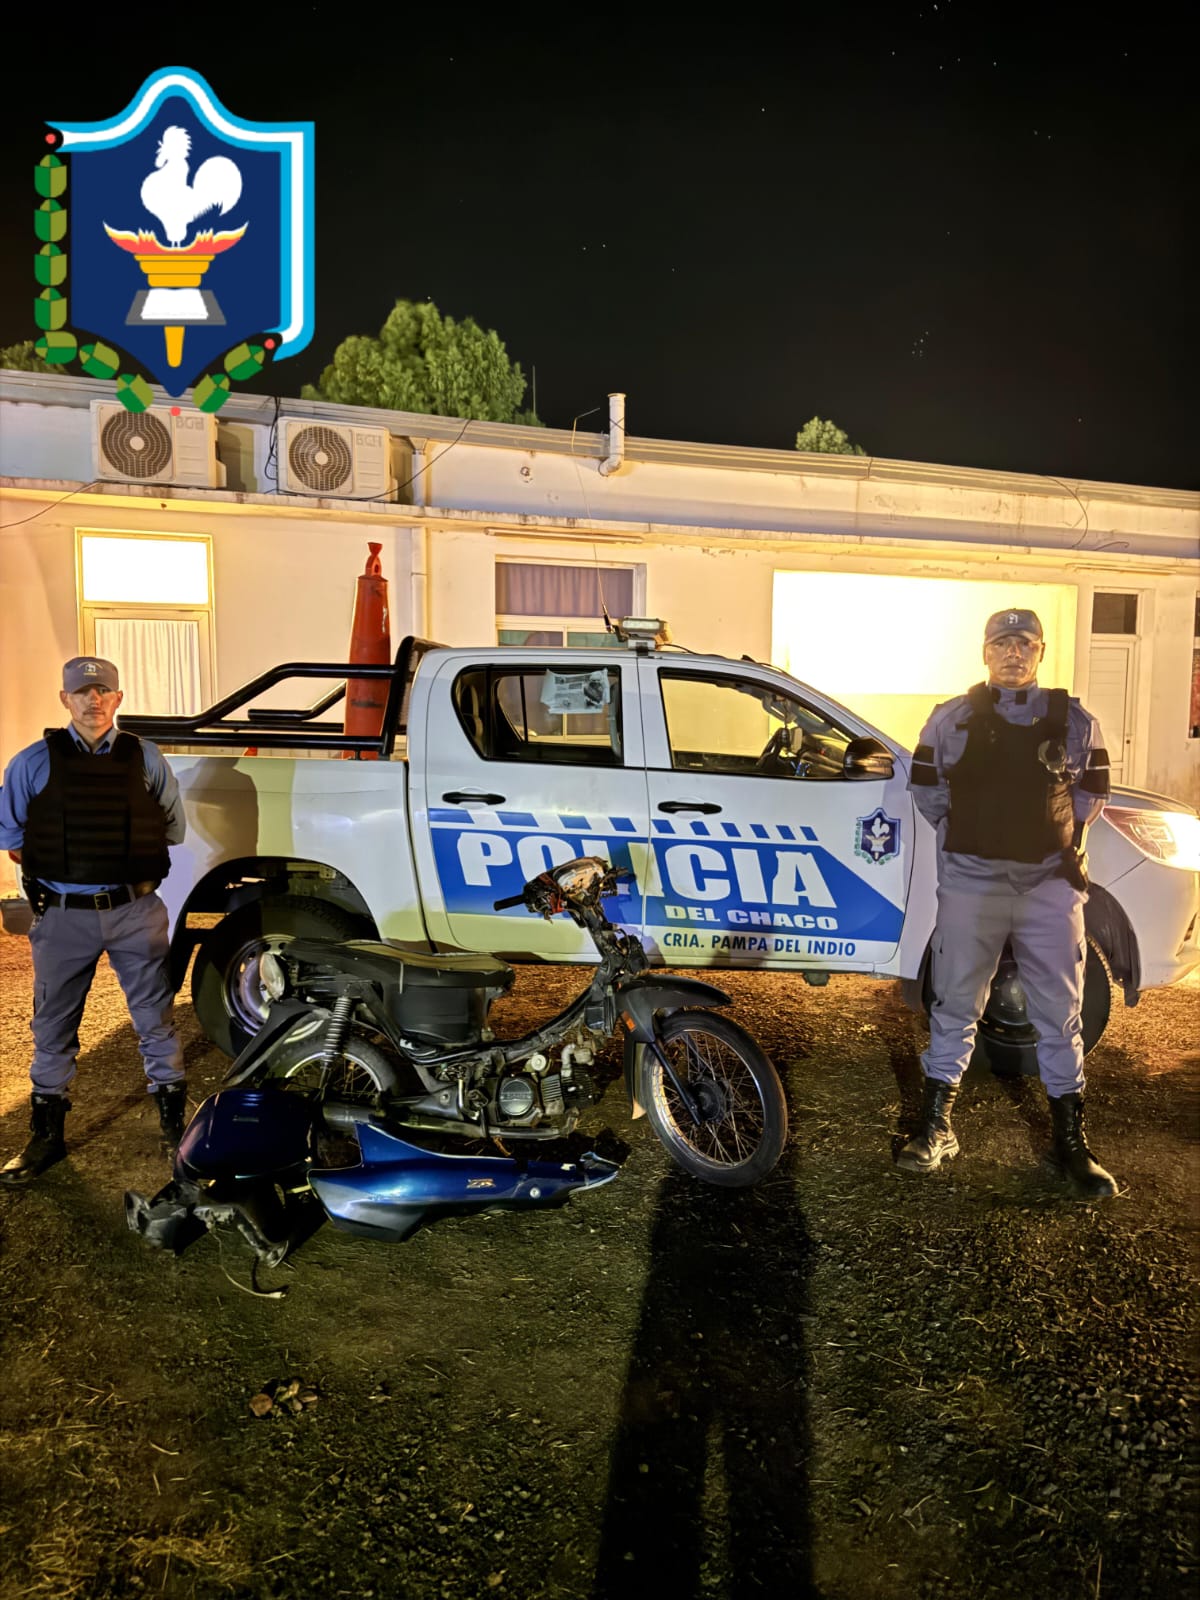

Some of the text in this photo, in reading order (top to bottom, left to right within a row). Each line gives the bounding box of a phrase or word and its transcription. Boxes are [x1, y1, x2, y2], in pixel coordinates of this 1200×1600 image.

[664, 905, 839, 931] DEL CHACO
[663, 932, 856, 956] CRIA. PAMPA DEL INDIO
